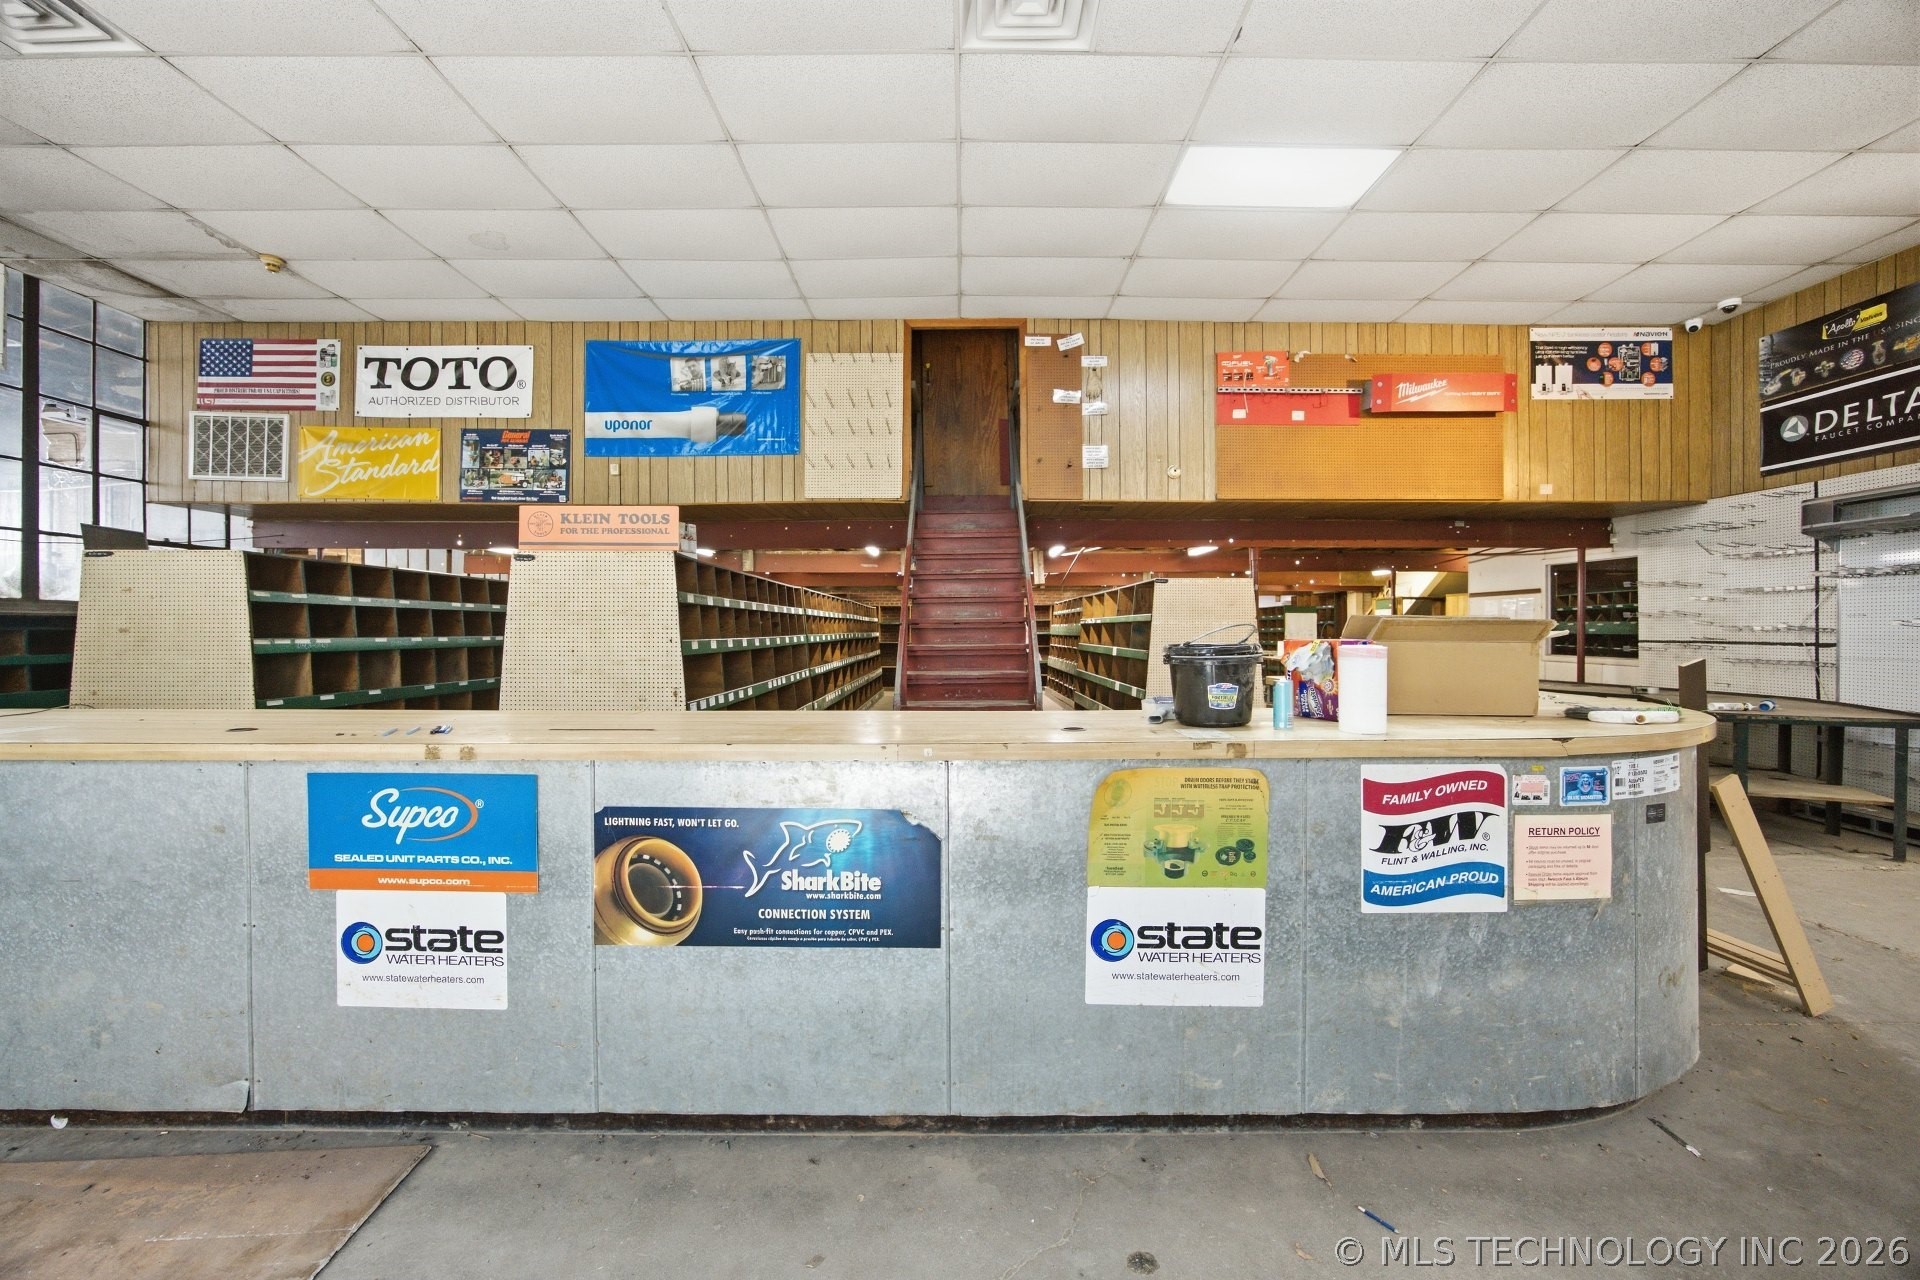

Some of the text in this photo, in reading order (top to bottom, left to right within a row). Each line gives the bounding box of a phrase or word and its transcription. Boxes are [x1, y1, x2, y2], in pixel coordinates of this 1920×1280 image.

[1769, 352, 1806, 370] PROUDLY
[1808, 344, 1835, 359] MADE
[1838, 339, 1849, 349] IN
[1852, 333, 1870, 345] THE
[364, 356, 518, 392] TOTO
[1395, 379, 1448, 399] Milwaukee
[367, 396, 520, 406] AUTHORIZED DISTRIBUTOR
[604, 419, 653, 433] uponor
[1814, 426, 1860, 443] FAUCET
[299, 429, 434, 464] American
[305, 447, 441, 496] Standard
[560, 513, 670, 525] KLEIN TOOLS
[560, 527, 670, 535] FOR THE PROFESSIONAL
[1382, 780, 1488, 805] FAMILY OWNED
[361, 787, 459, 845] Supco
[604, 817, 740, 829] LIGHTNING FAST, WON'T LET GO.
[1528, 827, 1600, 836] RETURN POLICY
[334, 854, 513, 866] SEALED UNIT PARTS CO., INC.
[1381, 843, 1489, 866] FLINT & WALLING, INC.
[378, 876, 470, 886] www.supco.com
[781, 870, 882, 892] SharkBite
[1370, 871, 1499, 897] AMERICAN PROUD
[806, 892, 882, 901] www.sharkbite.com
[758, 908, 871, 920] CONNECTION SYSTEM
[733, 927, 894, 937] Easy push-fit connections for copper, CPVC and PEX.
[1137, 922, 1262, 950] state
[384, 924, 505, 954] state
[386, 954, 505, 967] WATER HEATERS
[1138, 952, 1261, 963] WATER HEATERS
[362, 974, 485, 984] www.statewaterheaters.com
[1111, 972, 1240, 981] www.statewaterheaters.com
